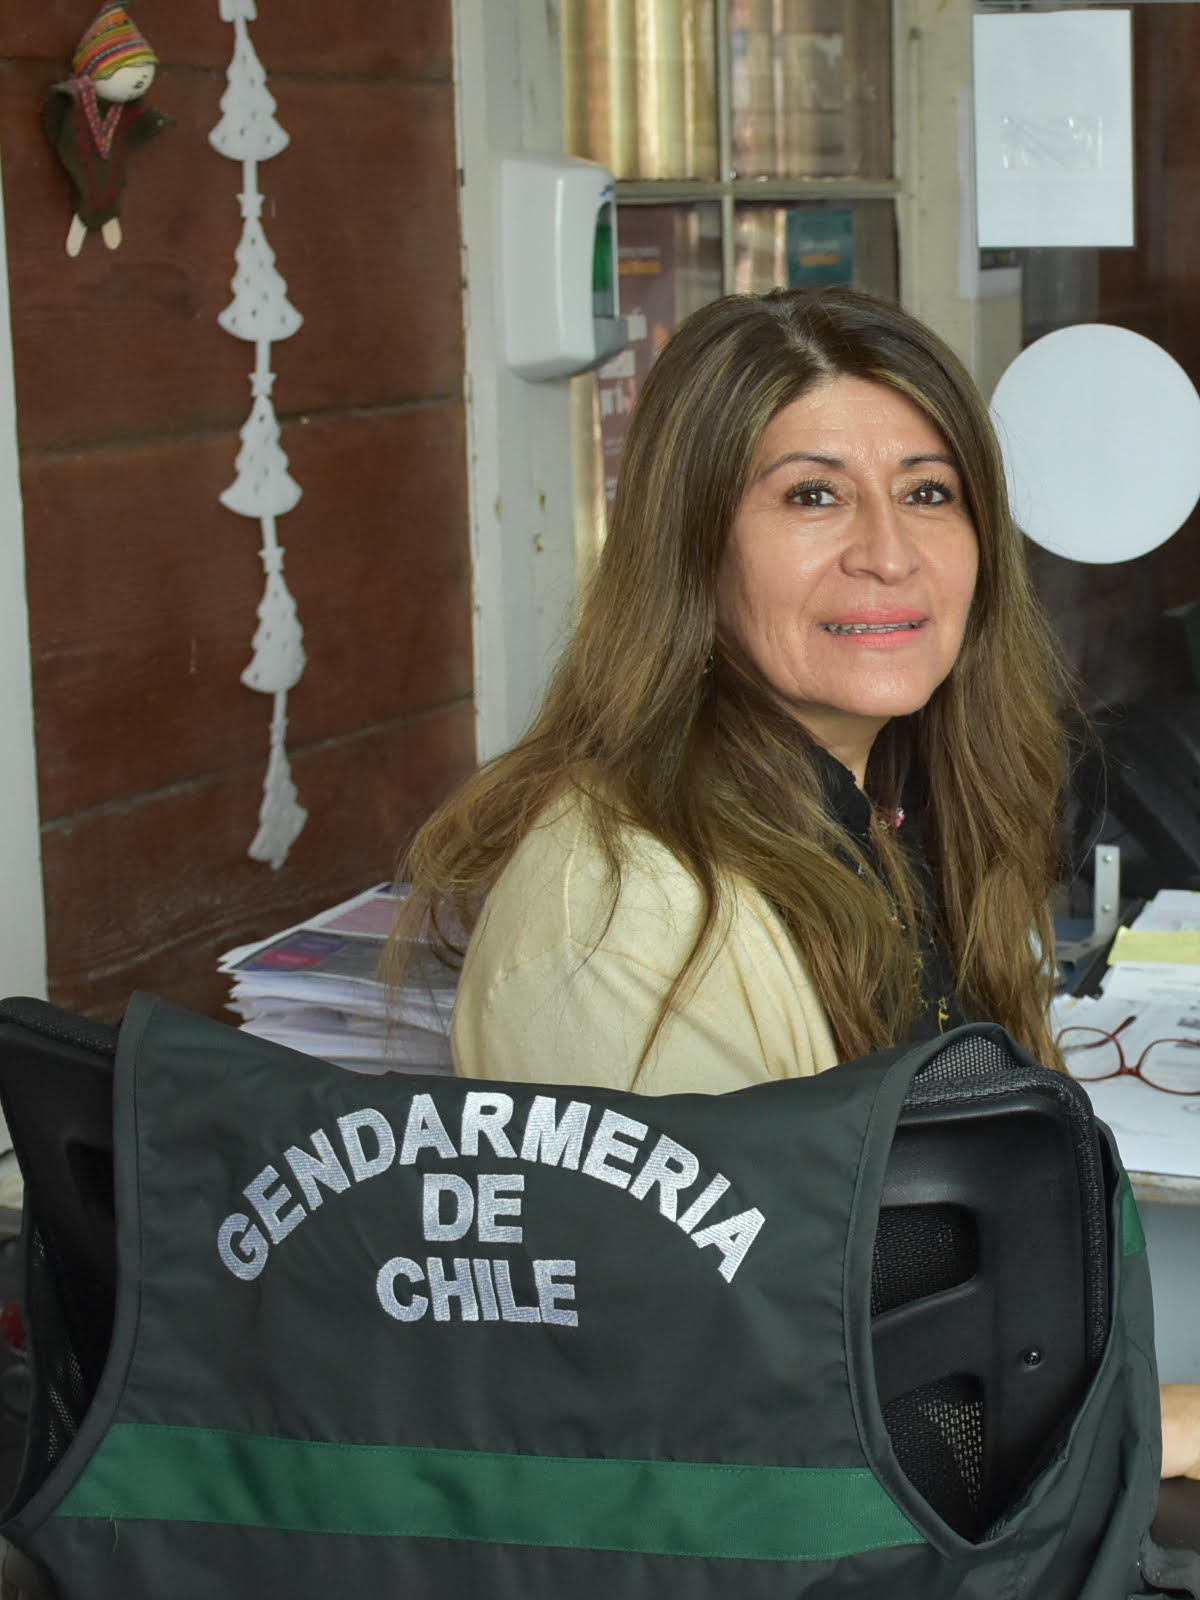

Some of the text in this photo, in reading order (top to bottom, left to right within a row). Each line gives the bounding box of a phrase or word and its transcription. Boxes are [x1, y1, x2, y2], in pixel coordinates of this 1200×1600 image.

[217, 1091, 766, 1284] GENDARMERIA
[422, 1172, 525, 1243] DE
[376, 1256, 579, 1328] CHILE
